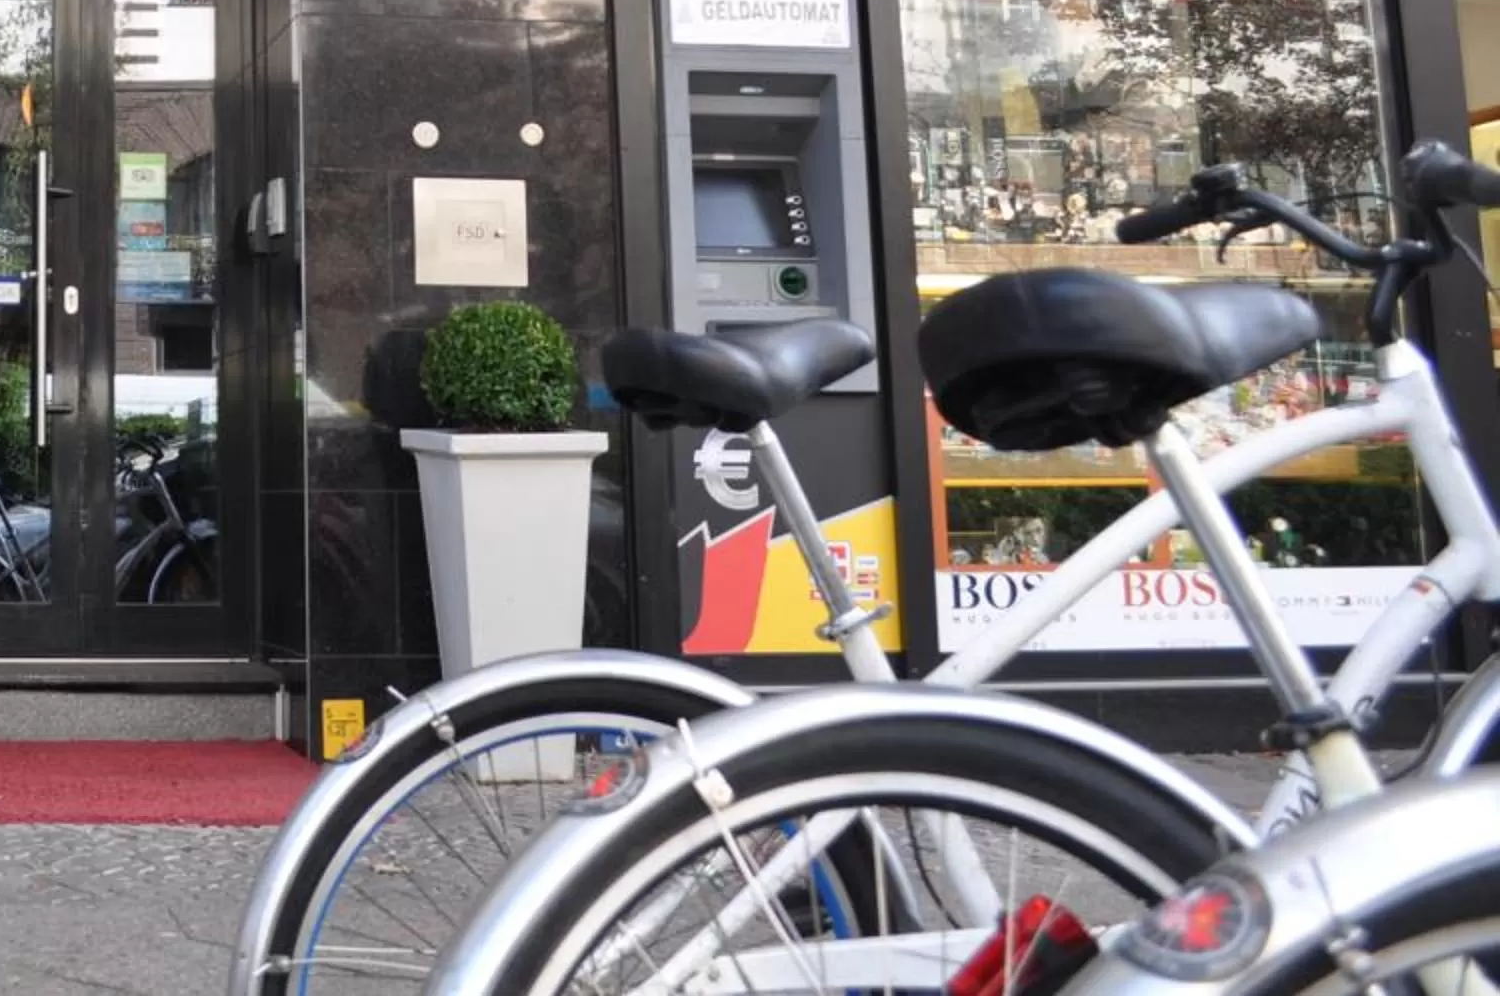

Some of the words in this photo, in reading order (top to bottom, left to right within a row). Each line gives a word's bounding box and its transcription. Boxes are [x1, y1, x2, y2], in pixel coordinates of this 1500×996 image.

[701, 0, 841, 24] GELDAUTOMAT
[952, 573, 1044, 610] BO
[1122, 570, 1230, 608] BOS
